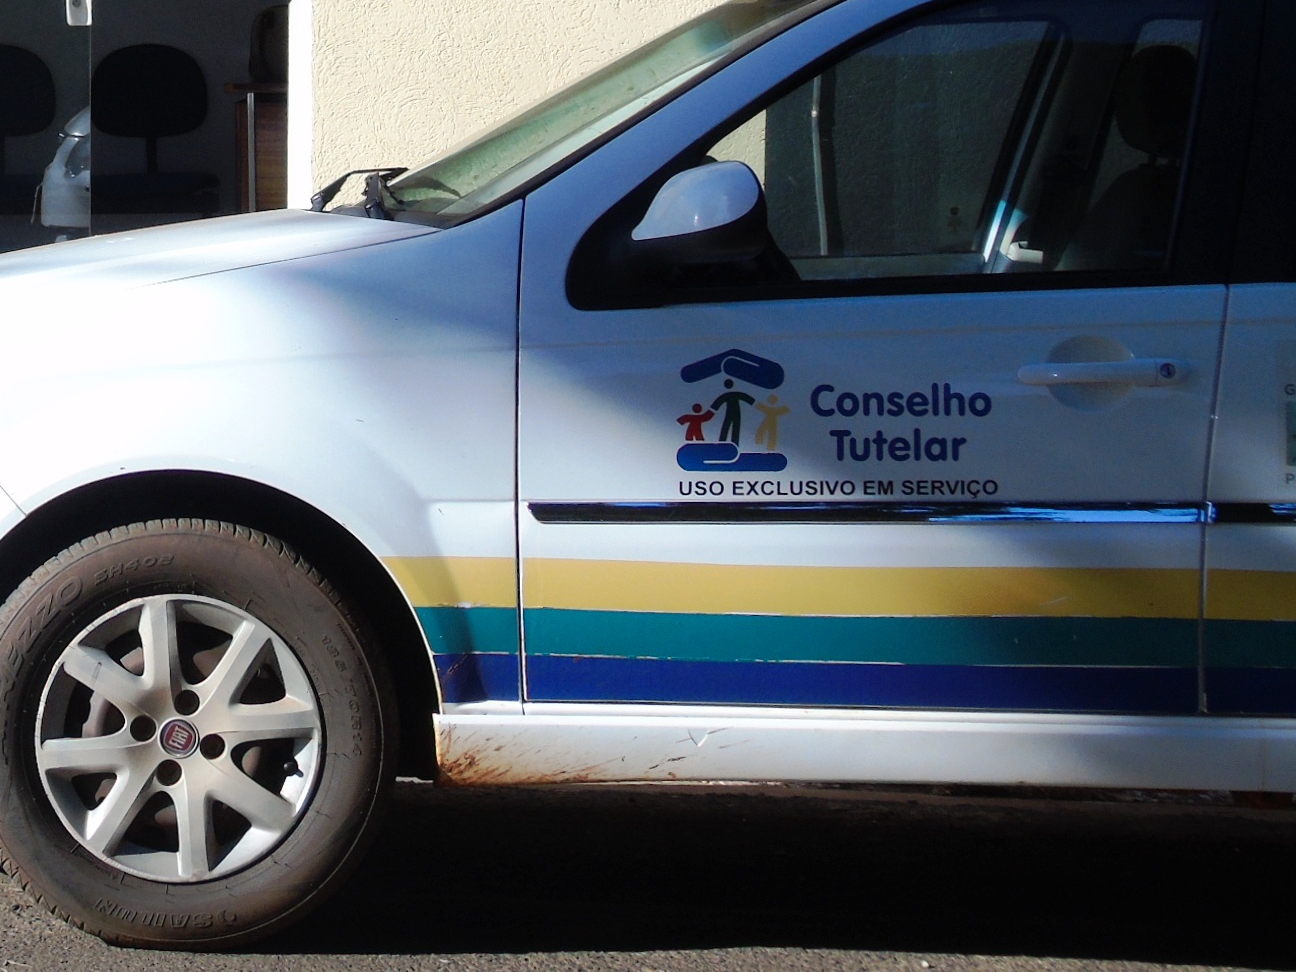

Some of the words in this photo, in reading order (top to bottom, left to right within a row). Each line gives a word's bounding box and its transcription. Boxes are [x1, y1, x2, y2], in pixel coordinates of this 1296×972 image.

[810, 383, 992, 418] Conselho
[830, 429, 967, 463] Tutelar
[678, 481, 725, 497] USO
[732, 481, 856, 497] EXCLUSIVO
[863, 480, 895, 497] EM
[901, 480, 998, 500] SERVIÇO
[168, 725, 190, 749] FIAT
